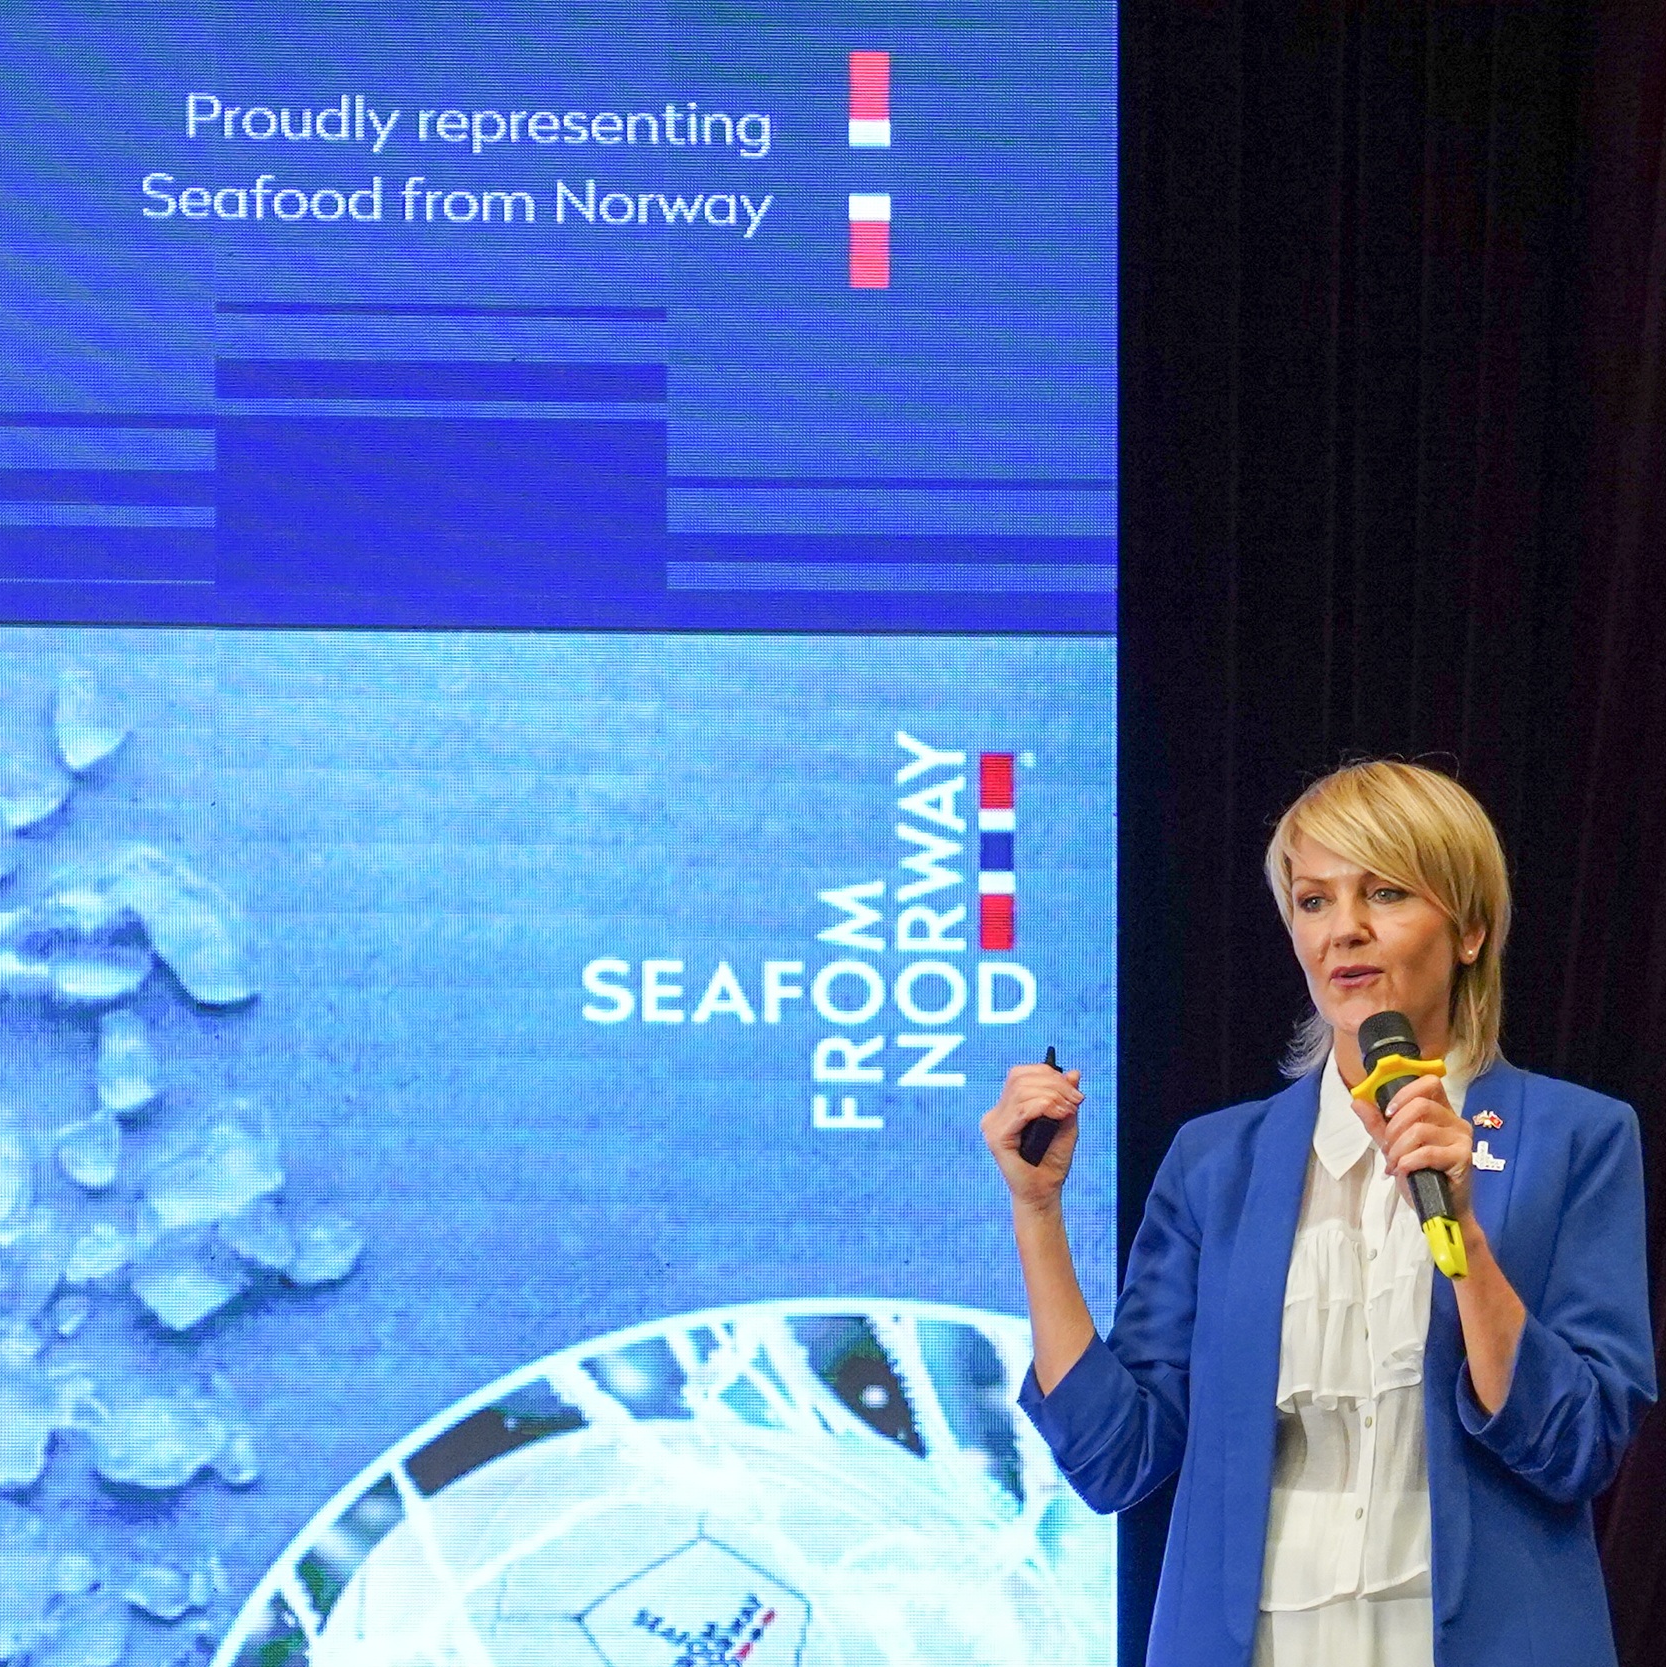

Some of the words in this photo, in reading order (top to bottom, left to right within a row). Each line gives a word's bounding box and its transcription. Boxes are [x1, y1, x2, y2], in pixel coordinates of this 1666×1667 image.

[183, 91, 399, 154] Proudly
[416, 101, 773, 158] representing
[141, 172, 383, 223] Seafood
[402, 175, 535, 223] from
[554, 178, 774, 239] Norway
[581, 957, 1038, 1025] SEAFOOD
